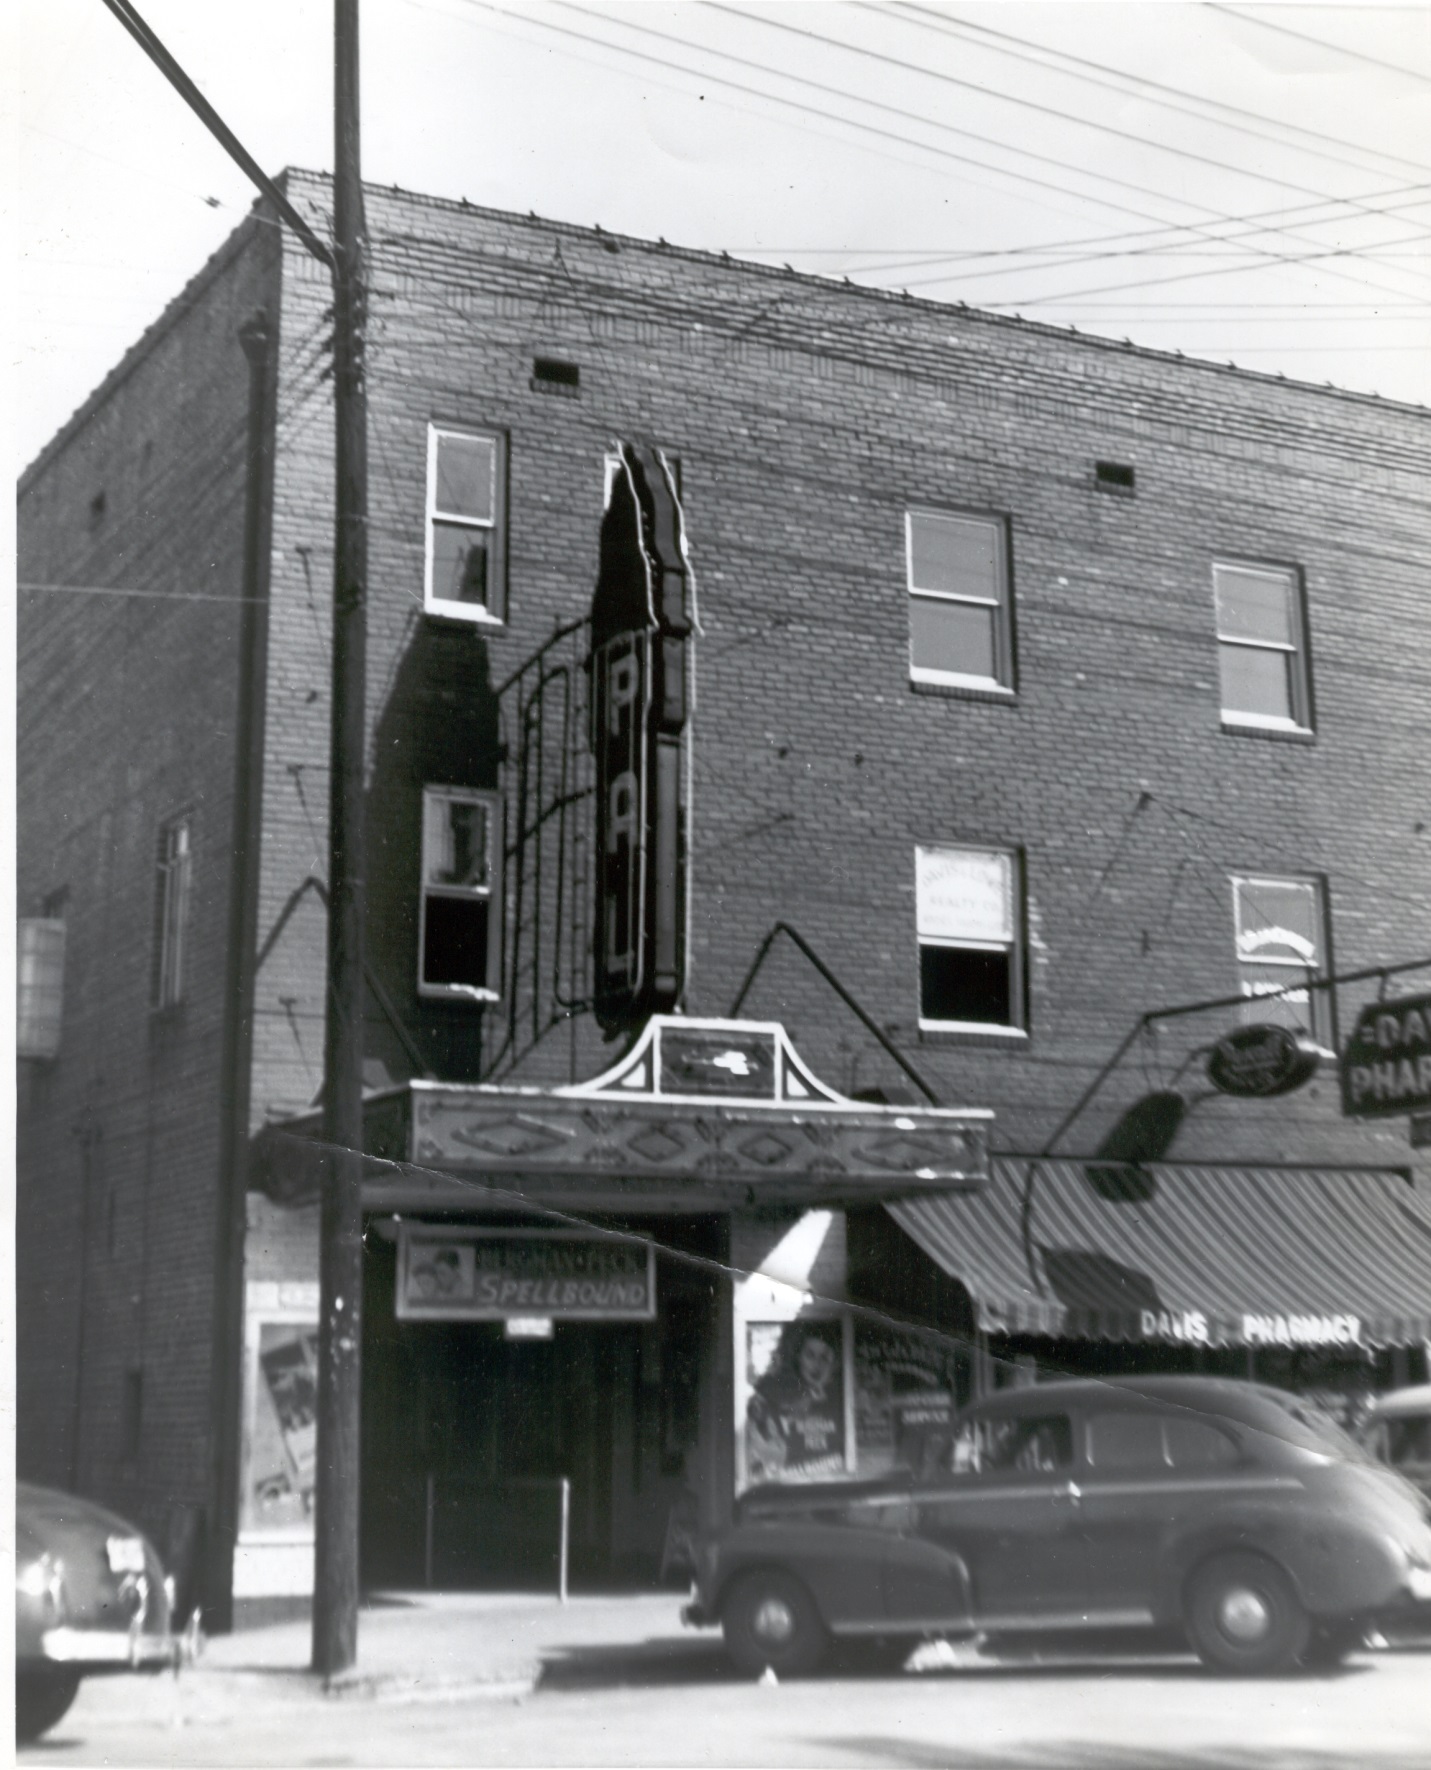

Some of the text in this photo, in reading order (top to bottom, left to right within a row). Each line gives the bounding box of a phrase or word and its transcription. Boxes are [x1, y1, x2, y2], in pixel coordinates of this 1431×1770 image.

[478, 1274, 646, 1306] SPELLBOUND
[1140, 1309, 1362, 1344] DAVIS PHARMACY
